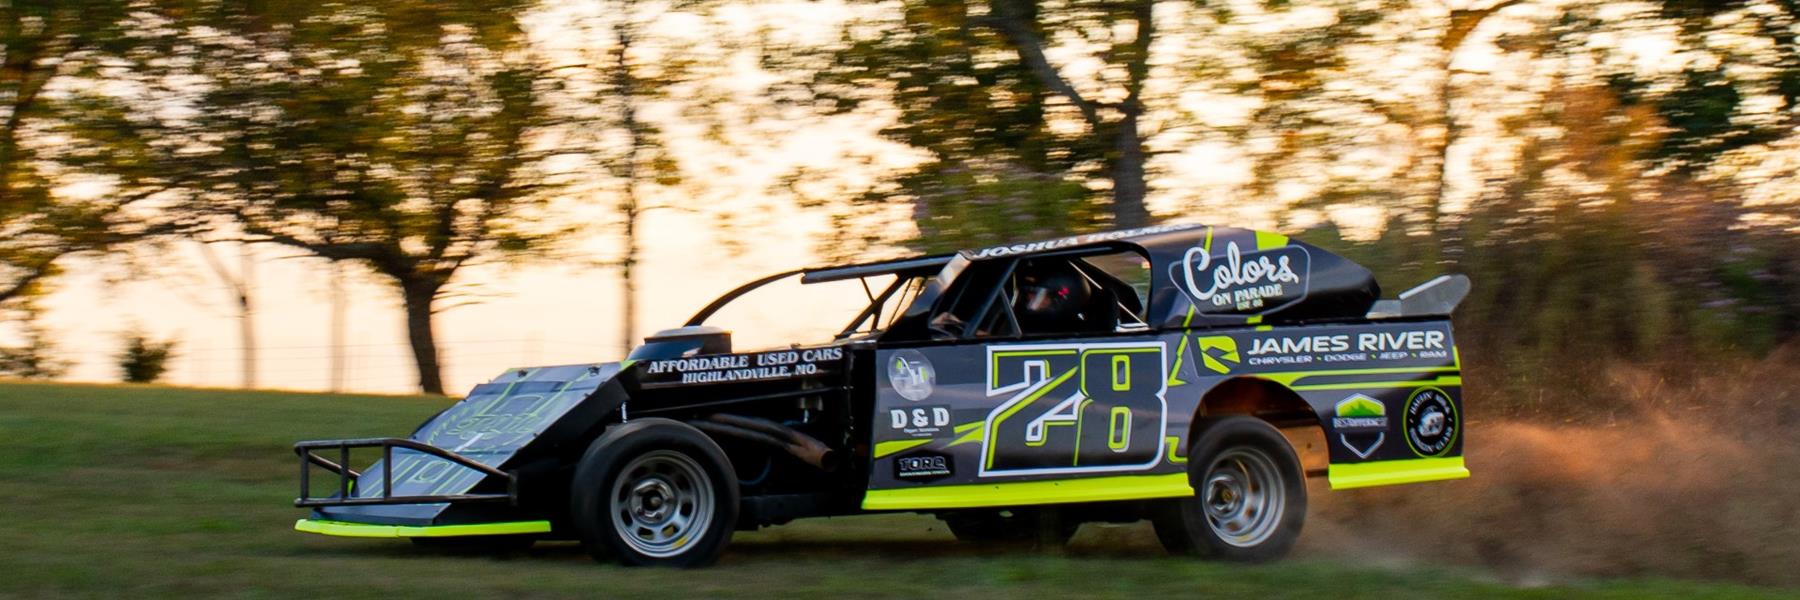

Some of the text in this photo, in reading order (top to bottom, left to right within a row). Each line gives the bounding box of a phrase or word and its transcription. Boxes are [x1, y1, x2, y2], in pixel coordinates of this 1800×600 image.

[973, 236, 1079, 258] JOSHUA
[1182, 241, 1299, 300] Colors
[1212, 291, 1232, 306] ON
[1234, 283, 1283, 302] PARADE
[1248, 330, 1445, 355] JAMES RIVER
[648, 347, 843, 374] AFFORDABLE USED CARS
[1248, 350, 1447, 366] CHRYSLER DODGE JEEP RAM
[682, 363, 817, 384] HIGHLANDVILLE, MO
[890, 407, 950, 428] D & D
[978, 341, 1168, 478] 28
